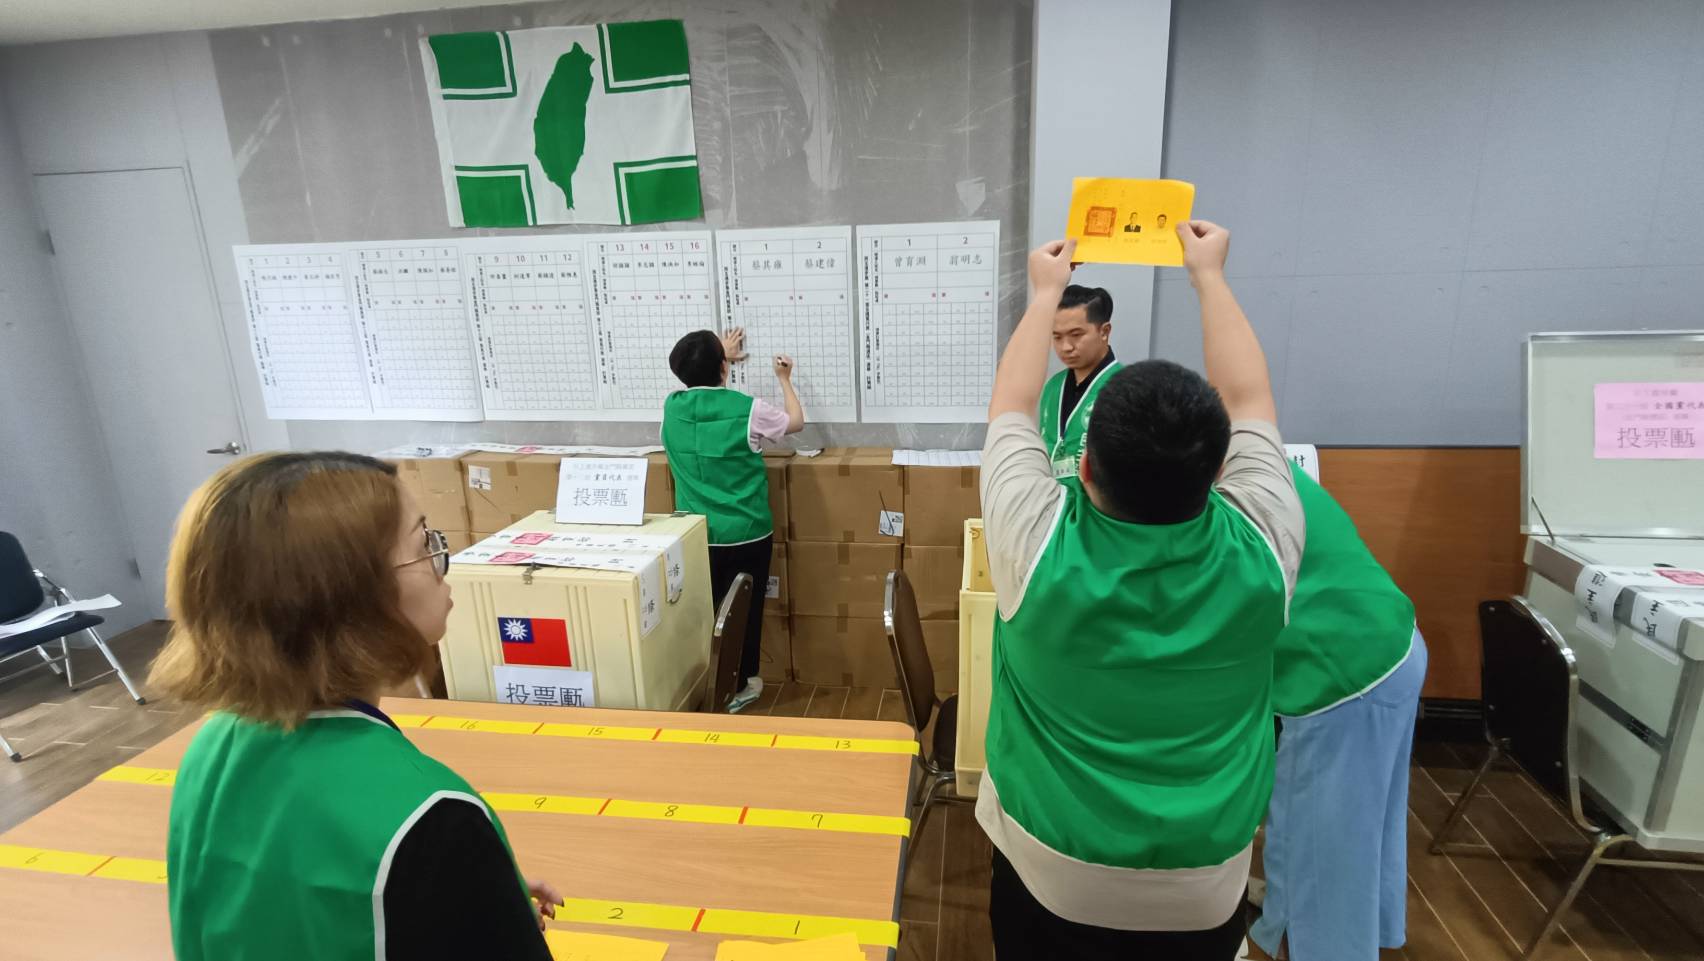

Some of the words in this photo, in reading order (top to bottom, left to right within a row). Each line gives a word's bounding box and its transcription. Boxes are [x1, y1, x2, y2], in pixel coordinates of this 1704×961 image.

[540, 254, 548, 262] 11
[640, 243, 649, 251] 14
[665, 242, 674, 250] 15
[690, 242, 699, 250] 16
[460, 720, 480, 731] 16
[588, 727, 606, 736] 15
[704, 733, 720, 743] 14
[835, 739, 851, 749] 13
[534, 797, 547, 809] 9
[664, 805, 678, 817] 8
[811, 813, 824, 829] 7
[25, 852, 45, 864] 6
[607, 907, 624, 919] 2
[794, 919, 801, 935] 1
